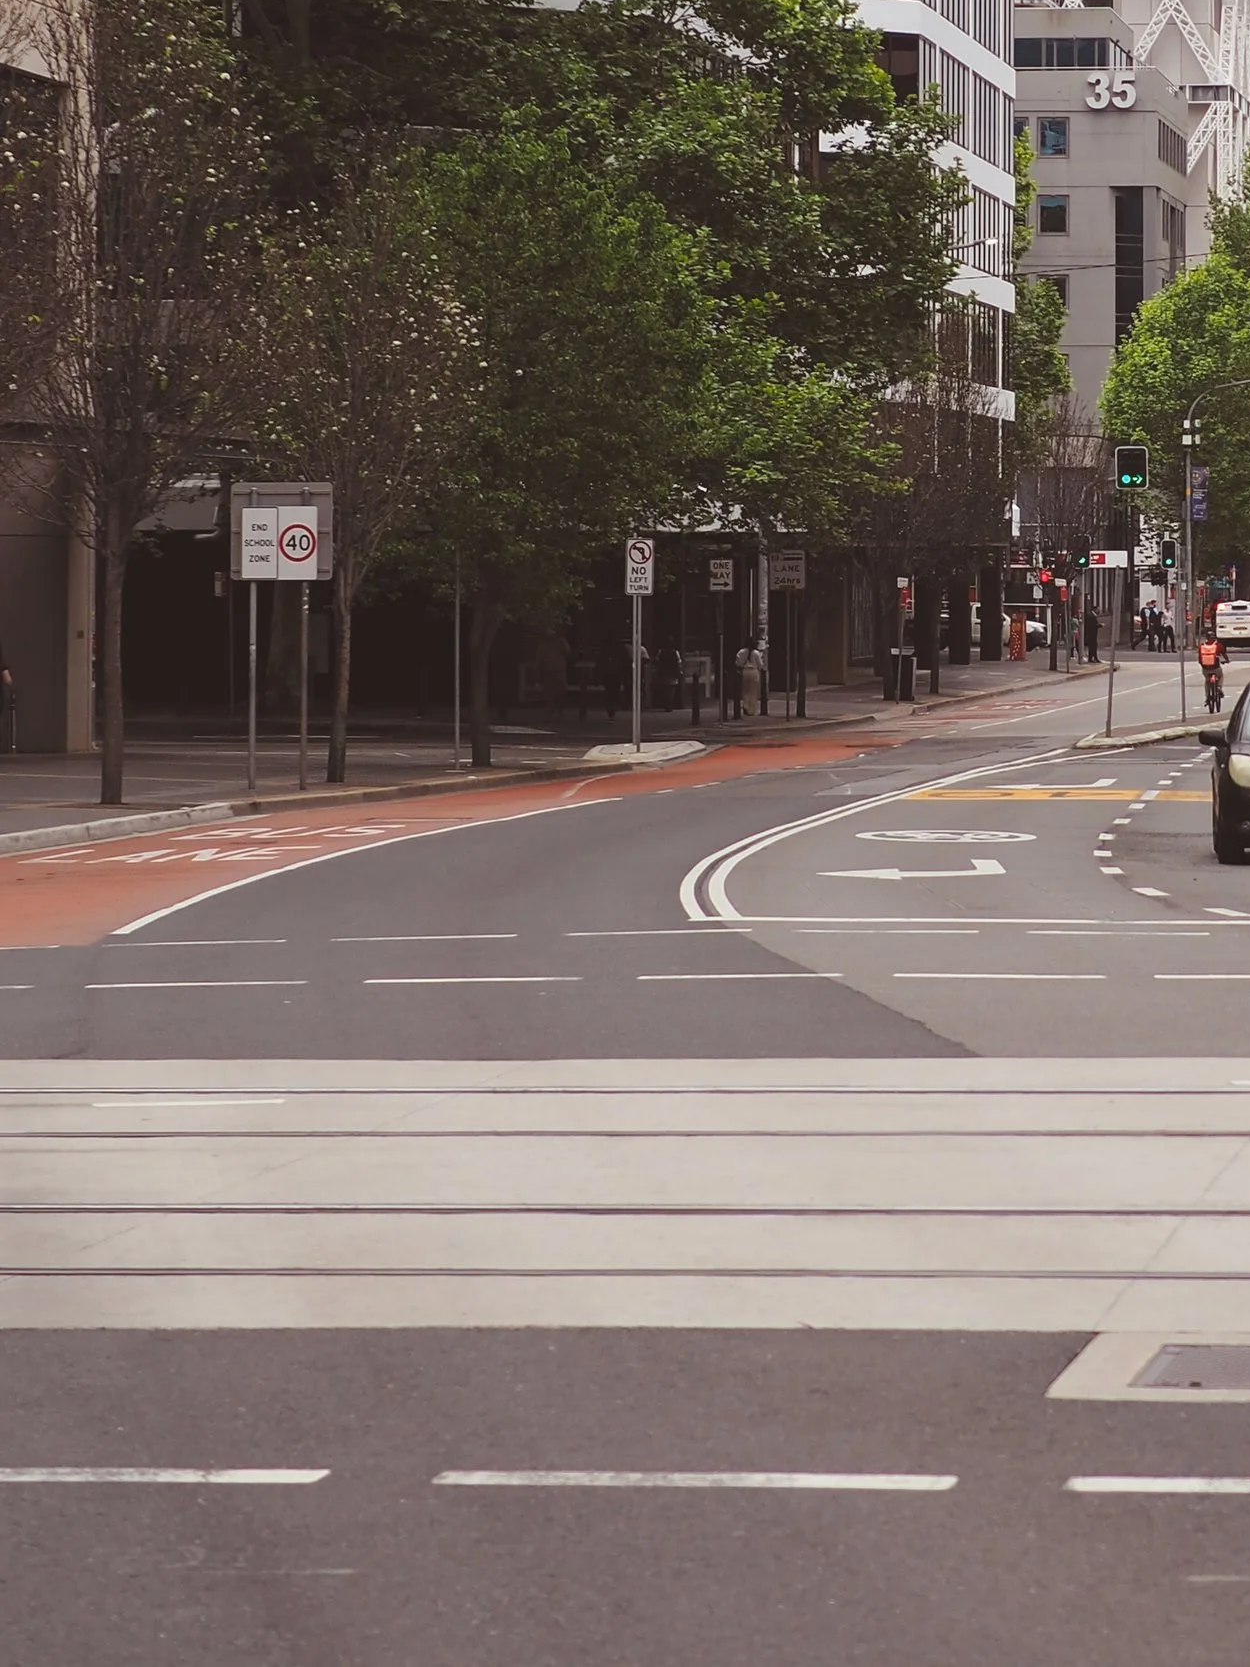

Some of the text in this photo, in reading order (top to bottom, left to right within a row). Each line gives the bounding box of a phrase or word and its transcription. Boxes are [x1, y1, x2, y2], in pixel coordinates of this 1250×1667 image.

[1086, 72, 1137, 109] 35
[251, 523, 268, 532] END
[244, 539, 275, 547] SCHOOL
[285, 534, 311, 551] 40
[249, 555, 271, 563] ZONE
[713, 562, 730, 570] ONE
[774, 565, 800, 573] LANE
[631, 567, 647, 575] NO
[168, 824, 406, 842] BUS
[17, 845, 322, 864] LANE
